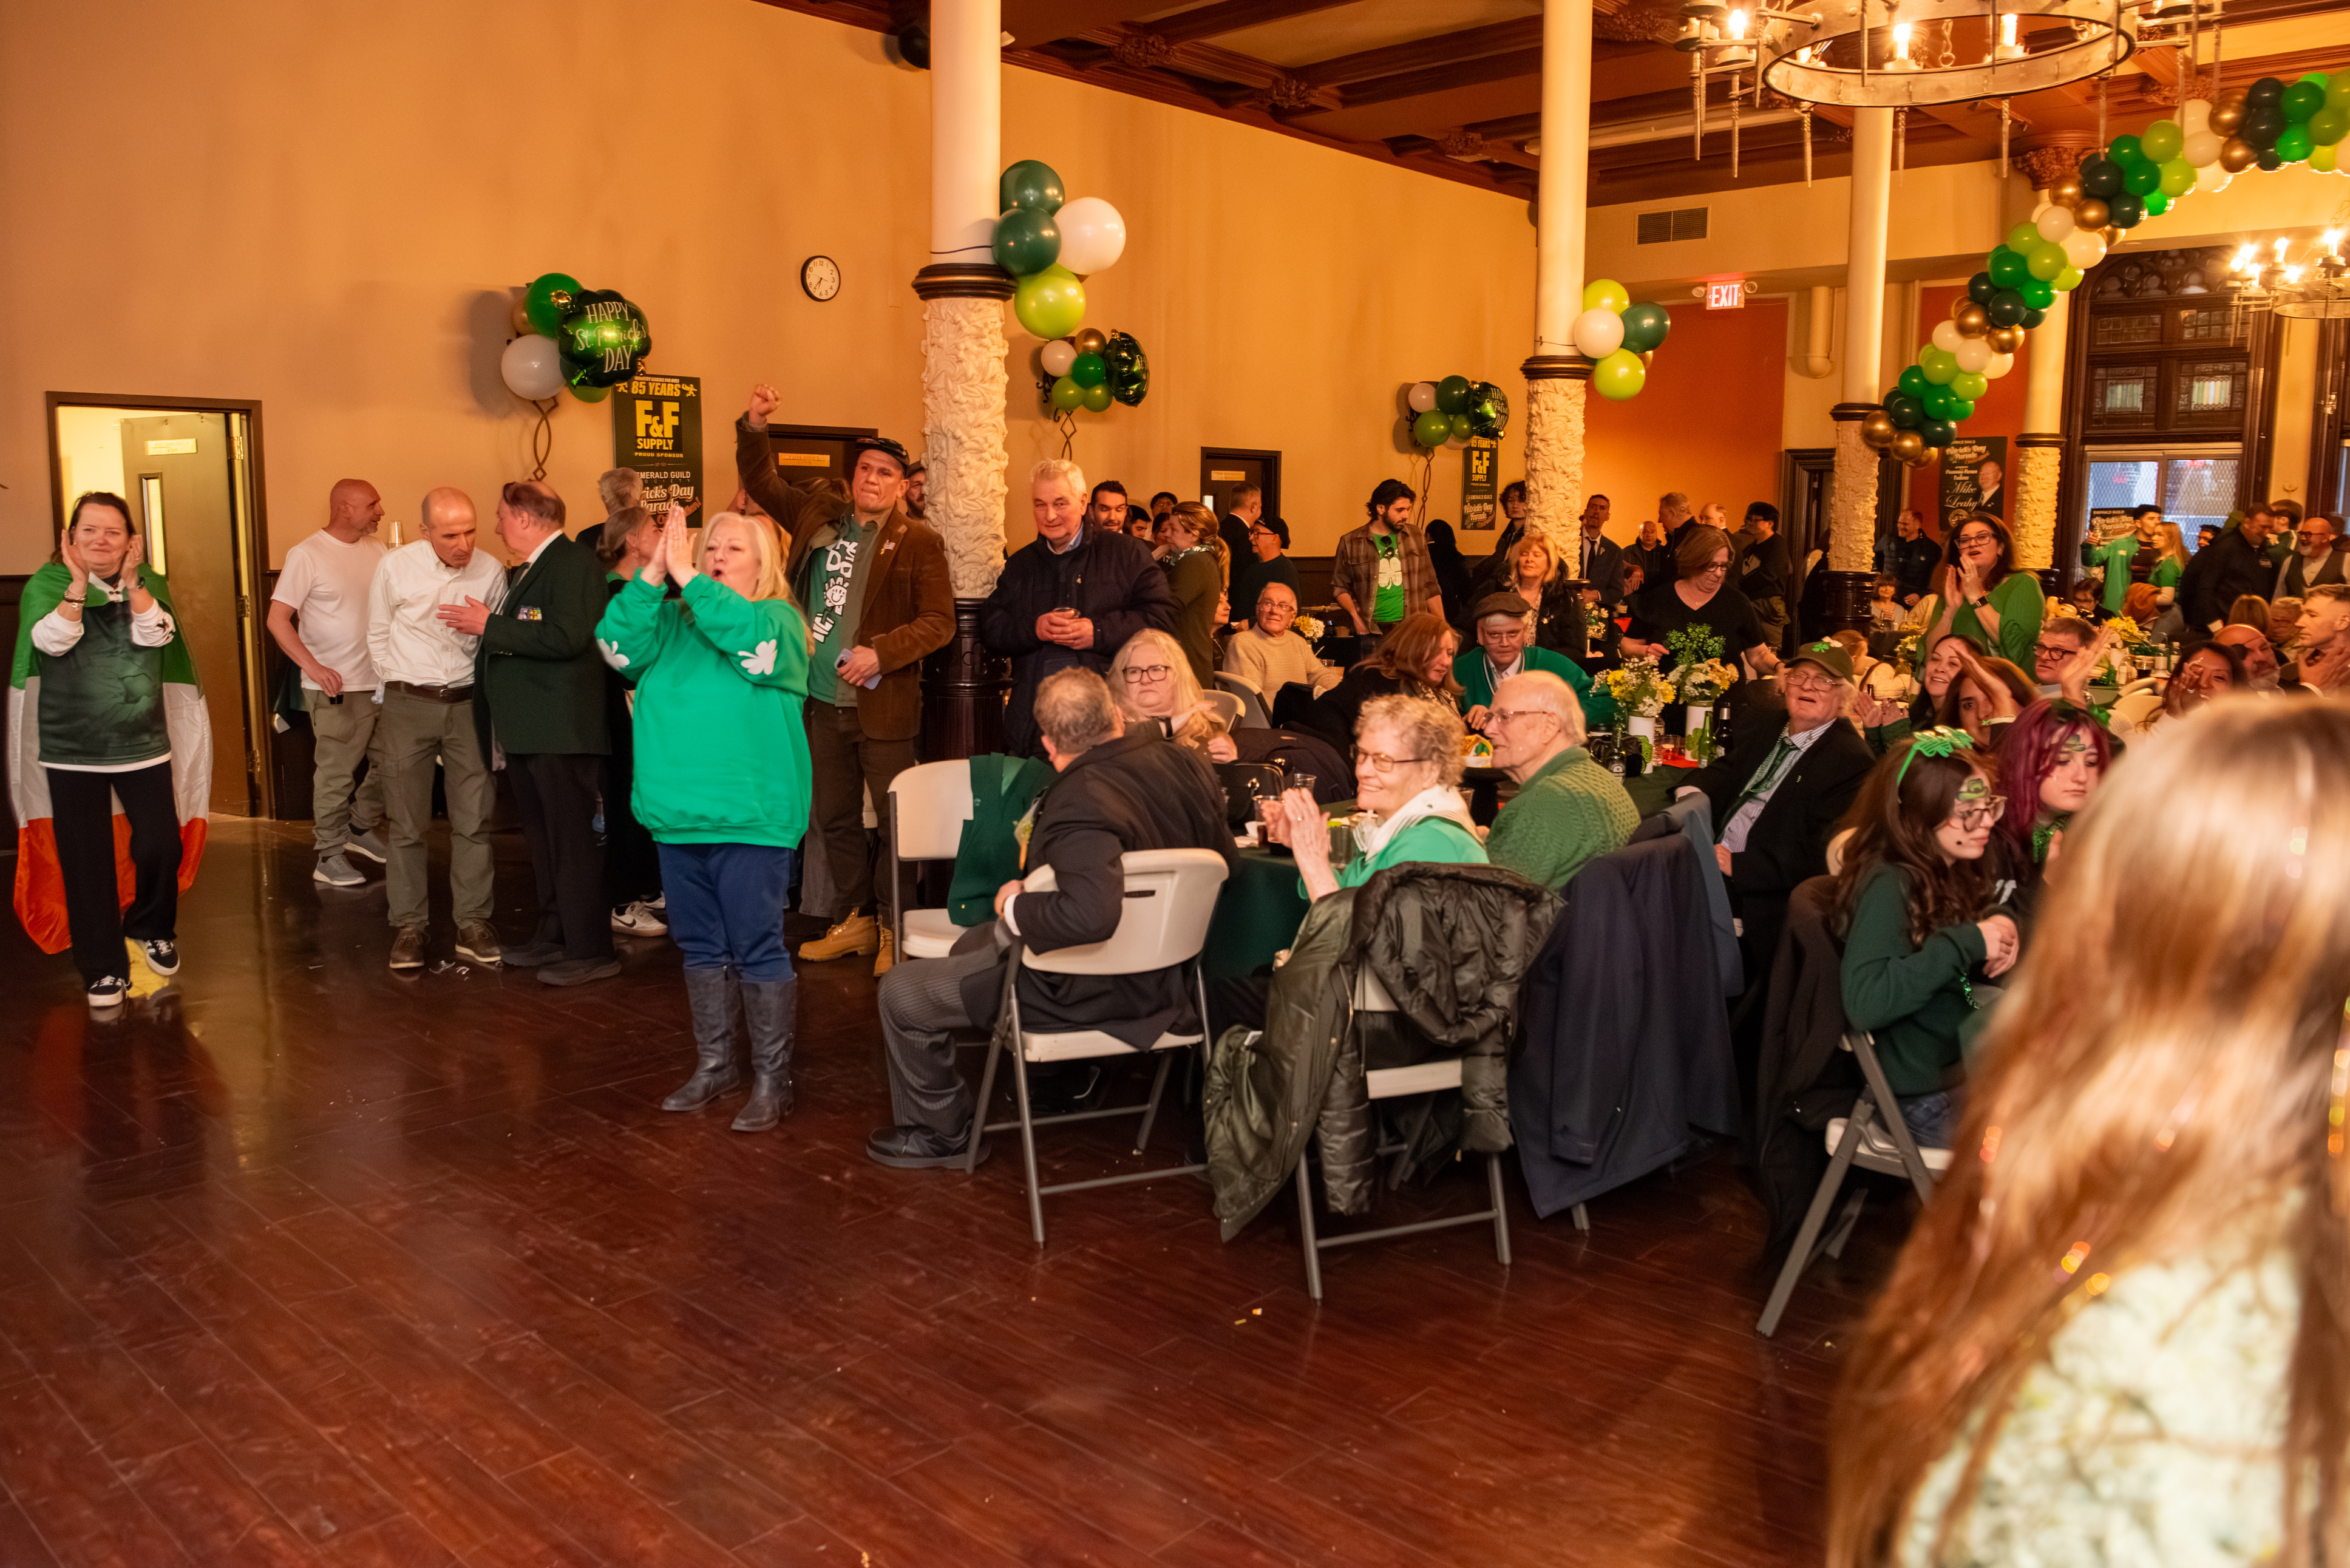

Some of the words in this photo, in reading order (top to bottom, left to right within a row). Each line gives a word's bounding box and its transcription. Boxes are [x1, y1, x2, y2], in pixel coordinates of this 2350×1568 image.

[1711, 284, 1740, 307] EXIT
[585, 301, 631, 323] HAPPY
[603, 344, 633, 373] DAY
[631, 381, 647, 395] 85
[648, 382, 681, 397] YEARS
[635, 400, 679, 438] F&F
[1492, 413, 1507, 430] DAY
[637, 438, 674, 450] SUPPLY
[1472, 450, 1490, 474] F&F
[642, 484, 668, 500] ick's
[670, 484, 694, 500] Day
[1483, 503, 1493, 512] Day
[1944, 495, 1978, 512] Leahy
